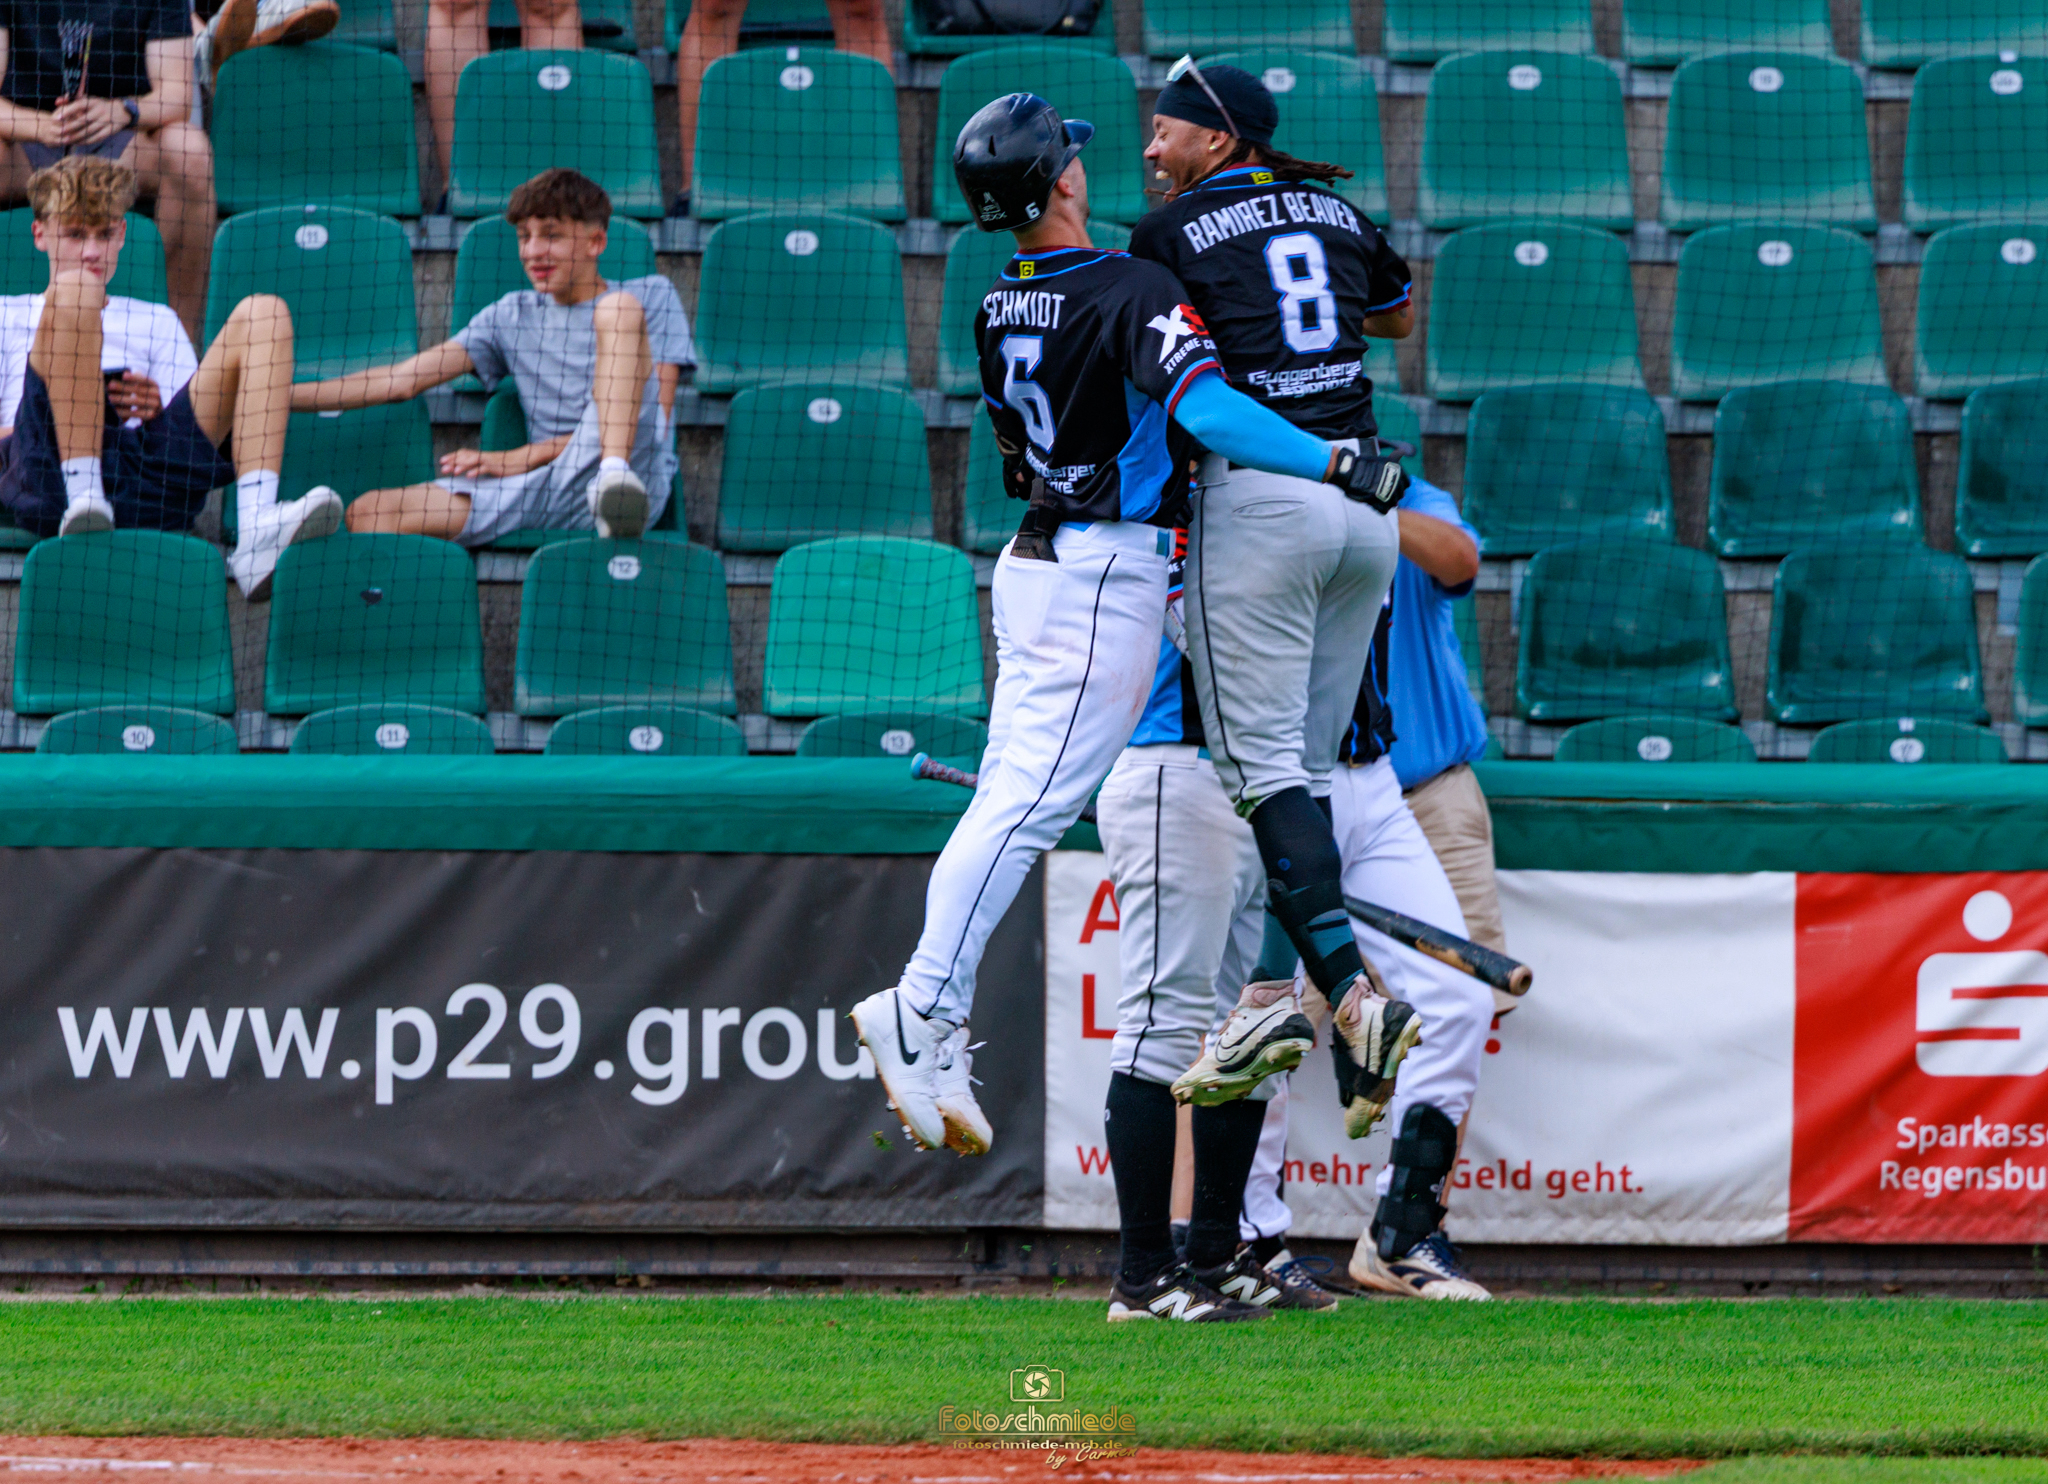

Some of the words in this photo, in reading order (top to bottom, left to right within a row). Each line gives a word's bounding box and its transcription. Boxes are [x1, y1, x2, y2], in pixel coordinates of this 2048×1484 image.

[1025, 201, 1041, 220] 6
[1182, 192, 1287, 254] RAMIREZ
[1281, 192, 1362, 235] BEAVER
[982, 290, 1066, 329] SCHMIDT
[1262, 230, 1341, 354] 8
[1163, 337, 1202, 375] XTREME
[1000, 333, 1057, 454] 6
[1896, 1114, 2048, 1155] Sparkass
[1453, 1158, 1532, 1191] Geld
[1545, 1161, 1644, 1199] geht.
